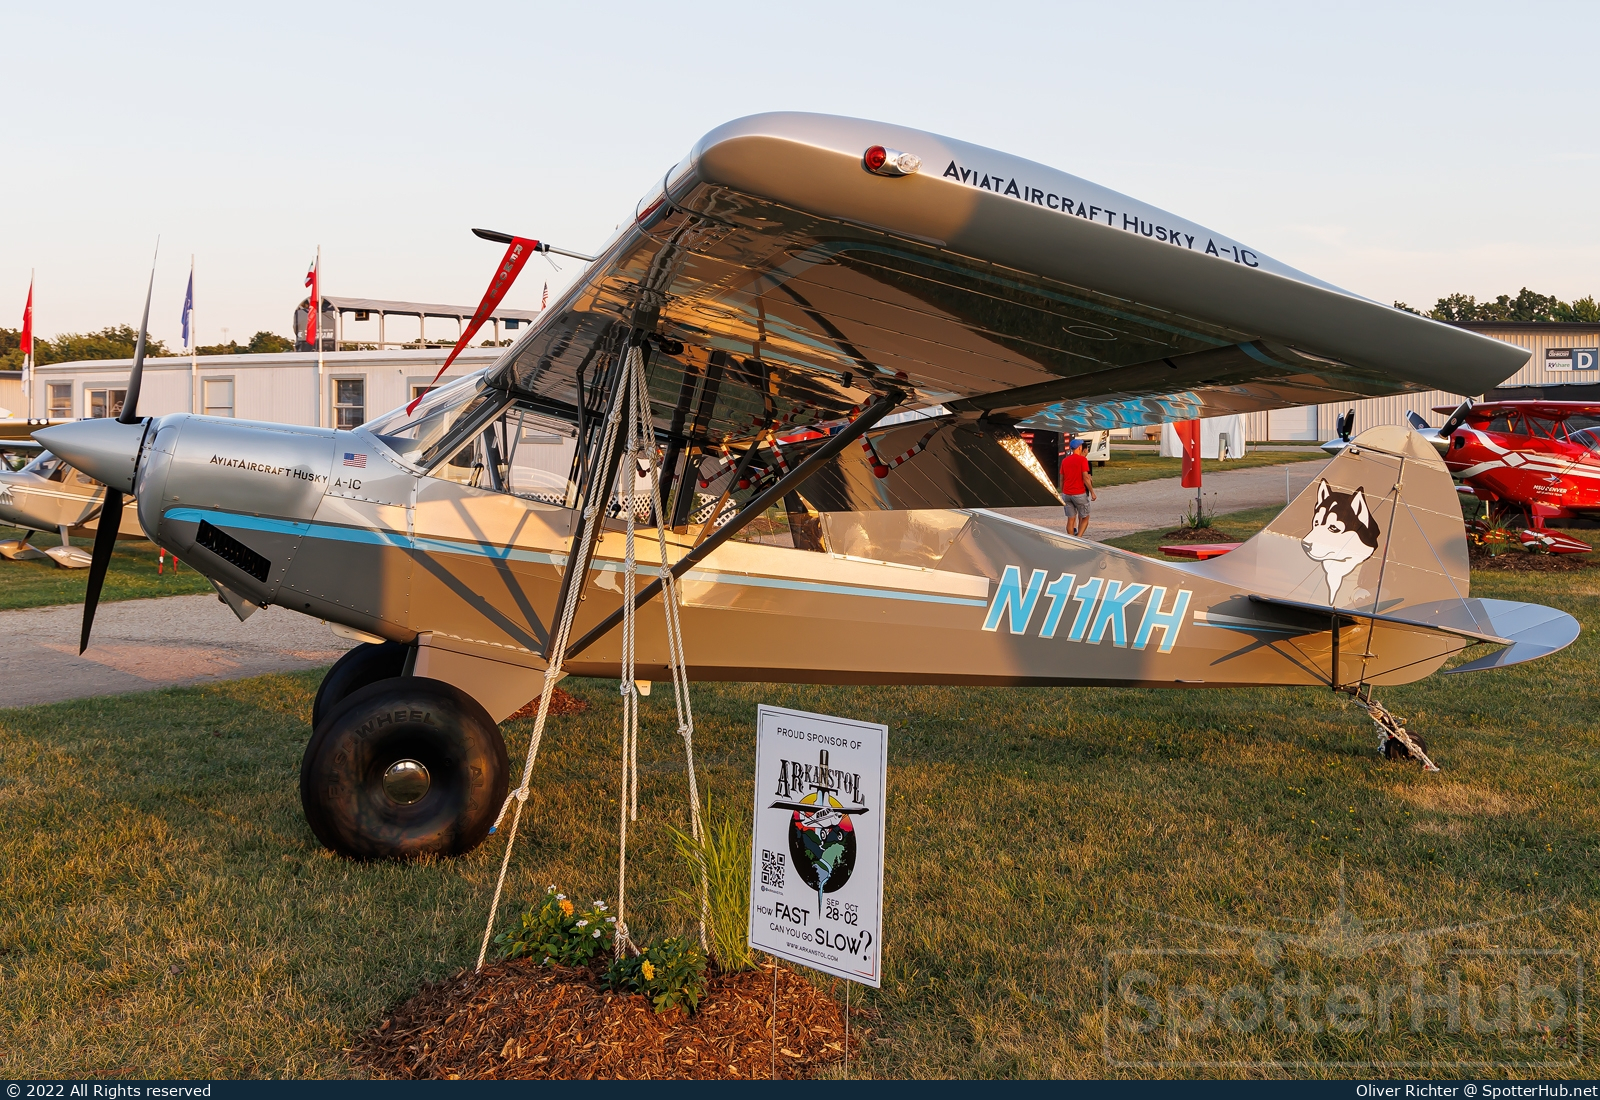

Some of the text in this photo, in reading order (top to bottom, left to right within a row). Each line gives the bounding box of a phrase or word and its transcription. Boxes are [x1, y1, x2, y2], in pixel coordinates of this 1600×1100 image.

[1123, 212, 1195, 250] HUSKY
[1204, 237, 1259, 269] A-1C
[490, 244, 523, 299] REMOVE
[1577, 352, 1593, 369] D
[293, 468, 328, 484] HUSKY
[981, 564, 1193, 654] N11KH
[777, 727, 862, 750] PROUD SPONSOR OF
[775, 759, 864, 805] ARKANSTOL
[757, 902, 810, 927] HOW FAST
[825, 906, 859, 927] 28-02
[826, 898, 859, 913] SEP OCT
[769, 922, 785, 934] CAN
[785, 926, 801, 939] YOU
[801, 931, 813, 942] GO
